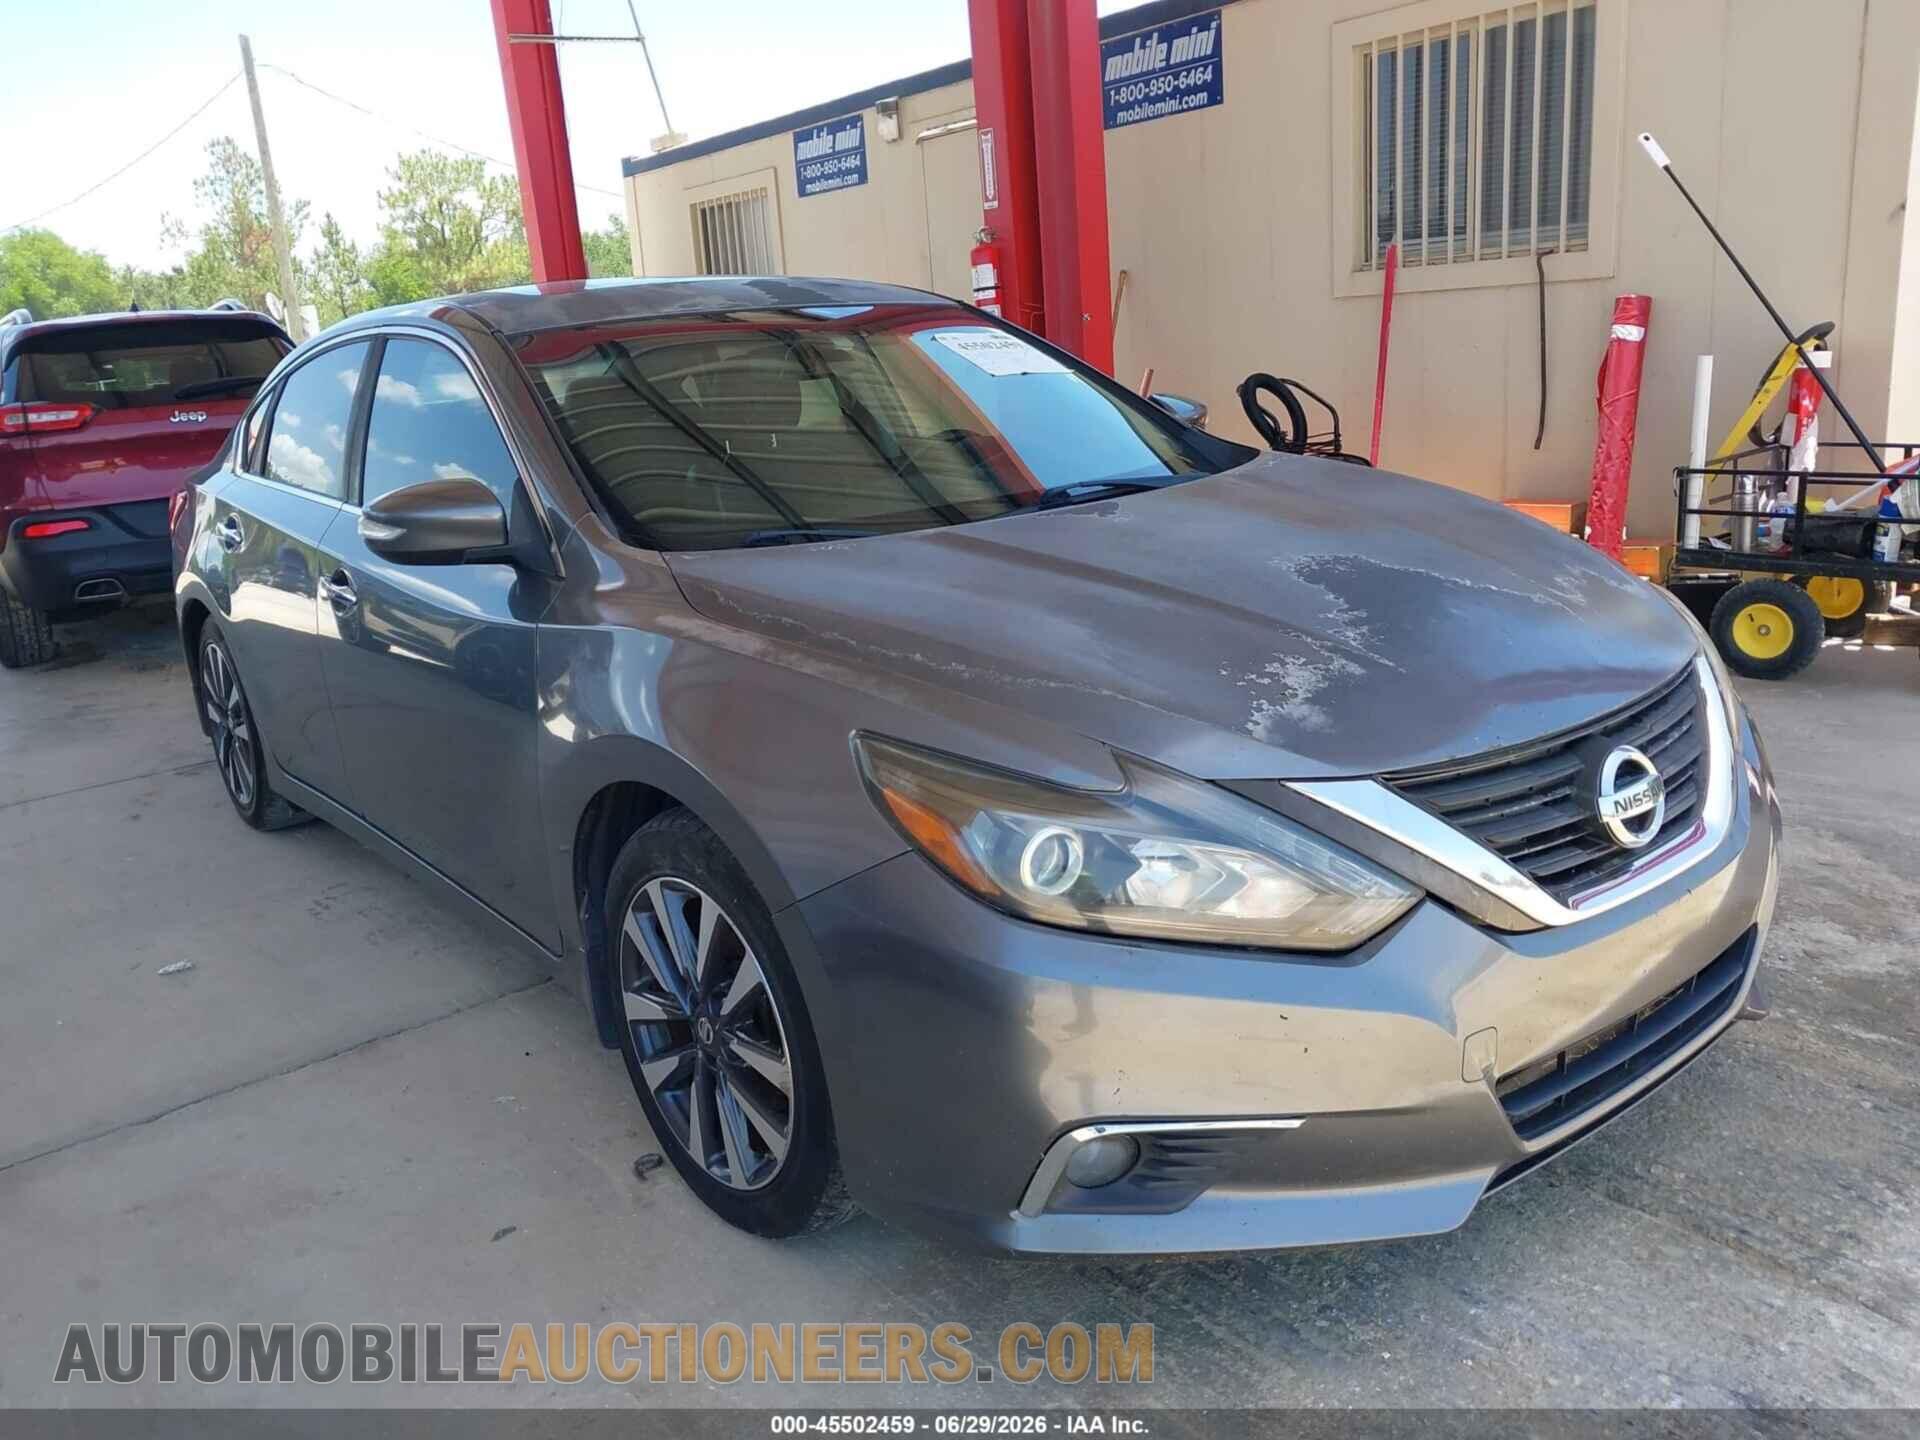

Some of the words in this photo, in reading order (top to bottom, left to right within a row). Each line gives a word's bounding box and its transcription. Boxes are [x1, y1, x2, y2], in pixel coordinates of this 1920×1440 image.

[1105, 33, 1168, 81] mobile
[1169, 21, 1217, 65] mini
[1110, 65, 1212, 106] 1-800-950-6464
[1117, 92, 1208, 124] mobilemini.com
[797, 127, 833, 160] mobile
[835, 122, 862, 151] mini
[800, 153, 861, 180] 1-800-950-6464
[805, 174, 858, 193] mobilemini.com
[169, 410, 207, 422] Jeep
